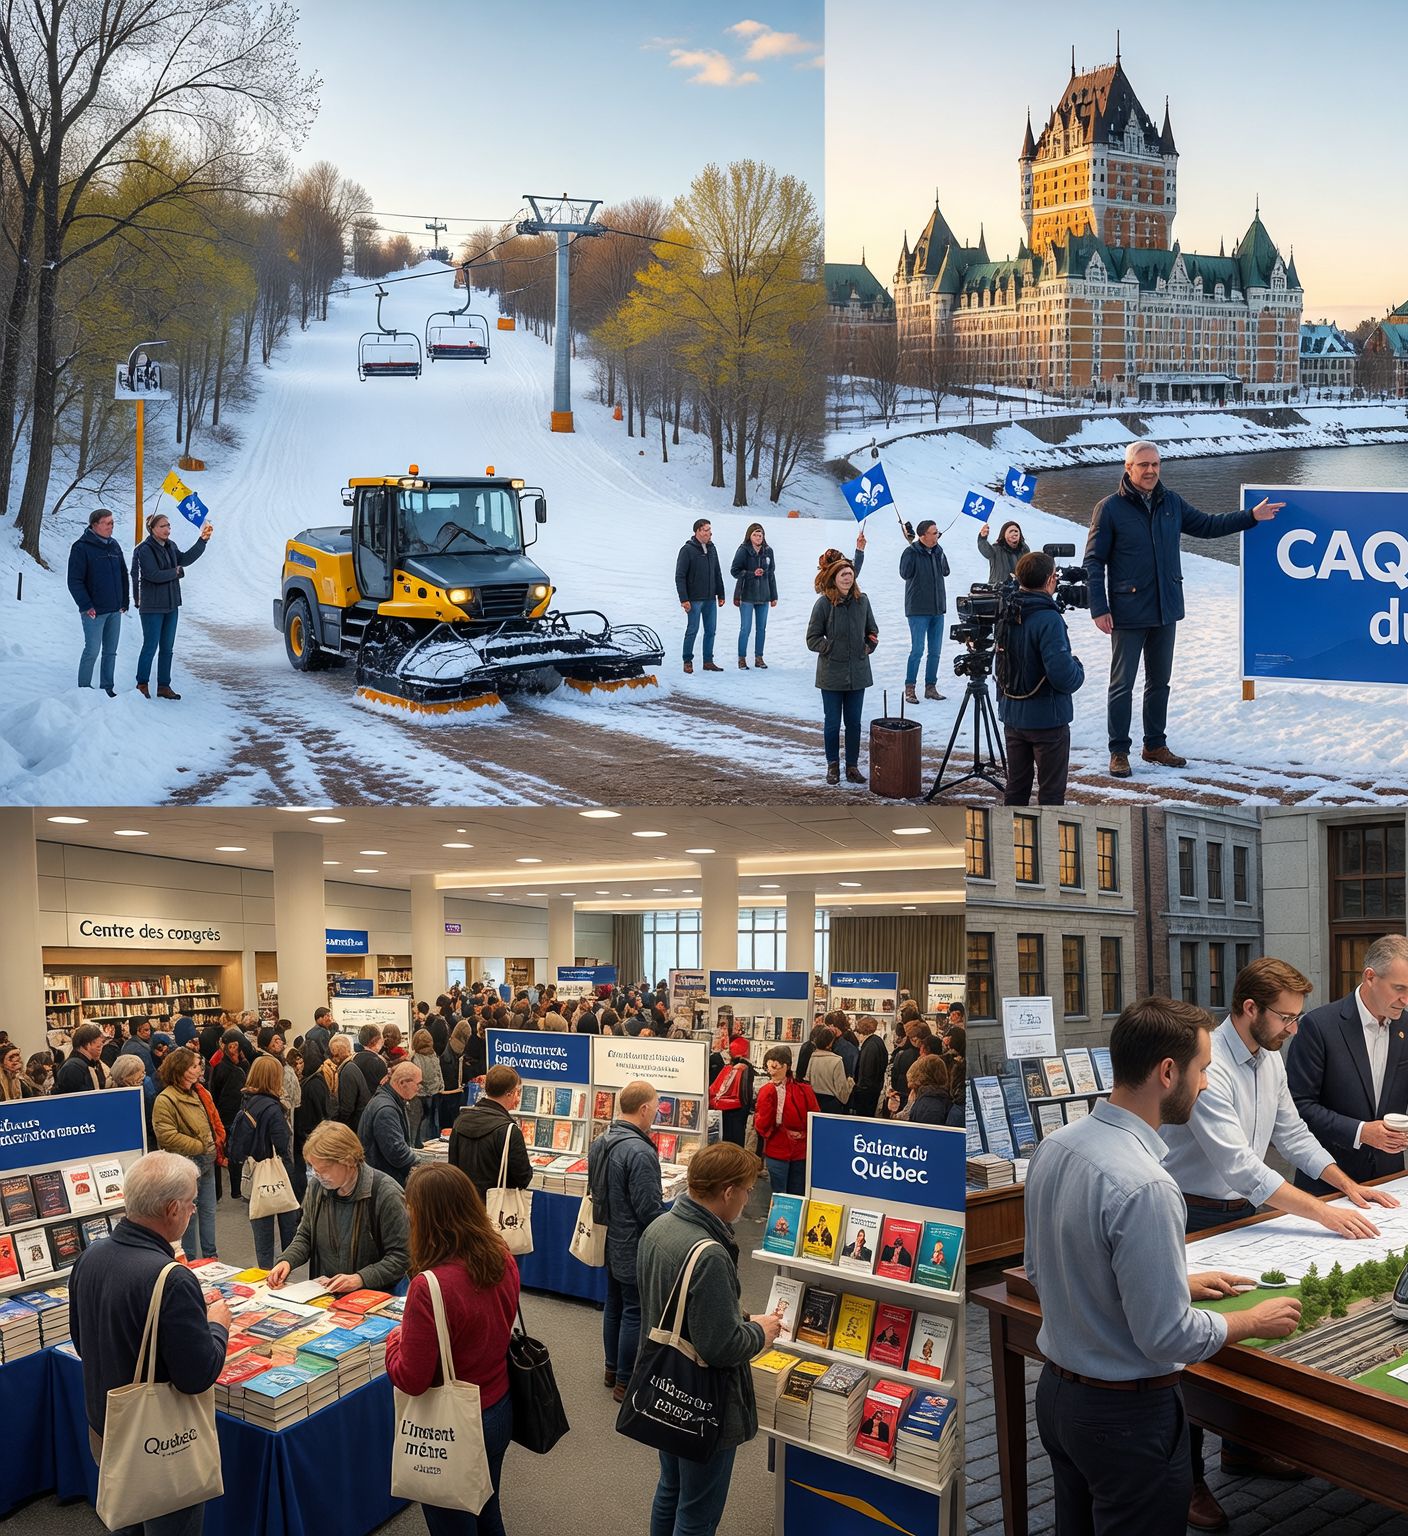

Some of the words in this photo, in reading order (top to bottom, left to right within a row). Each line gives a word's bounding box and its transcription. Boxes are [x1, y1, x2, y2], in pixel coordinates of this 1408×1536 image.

[79, 919, 135, 939] Centre
[139, 923, 164, 940] des
[851, 1156, 929, 1185] Québec
